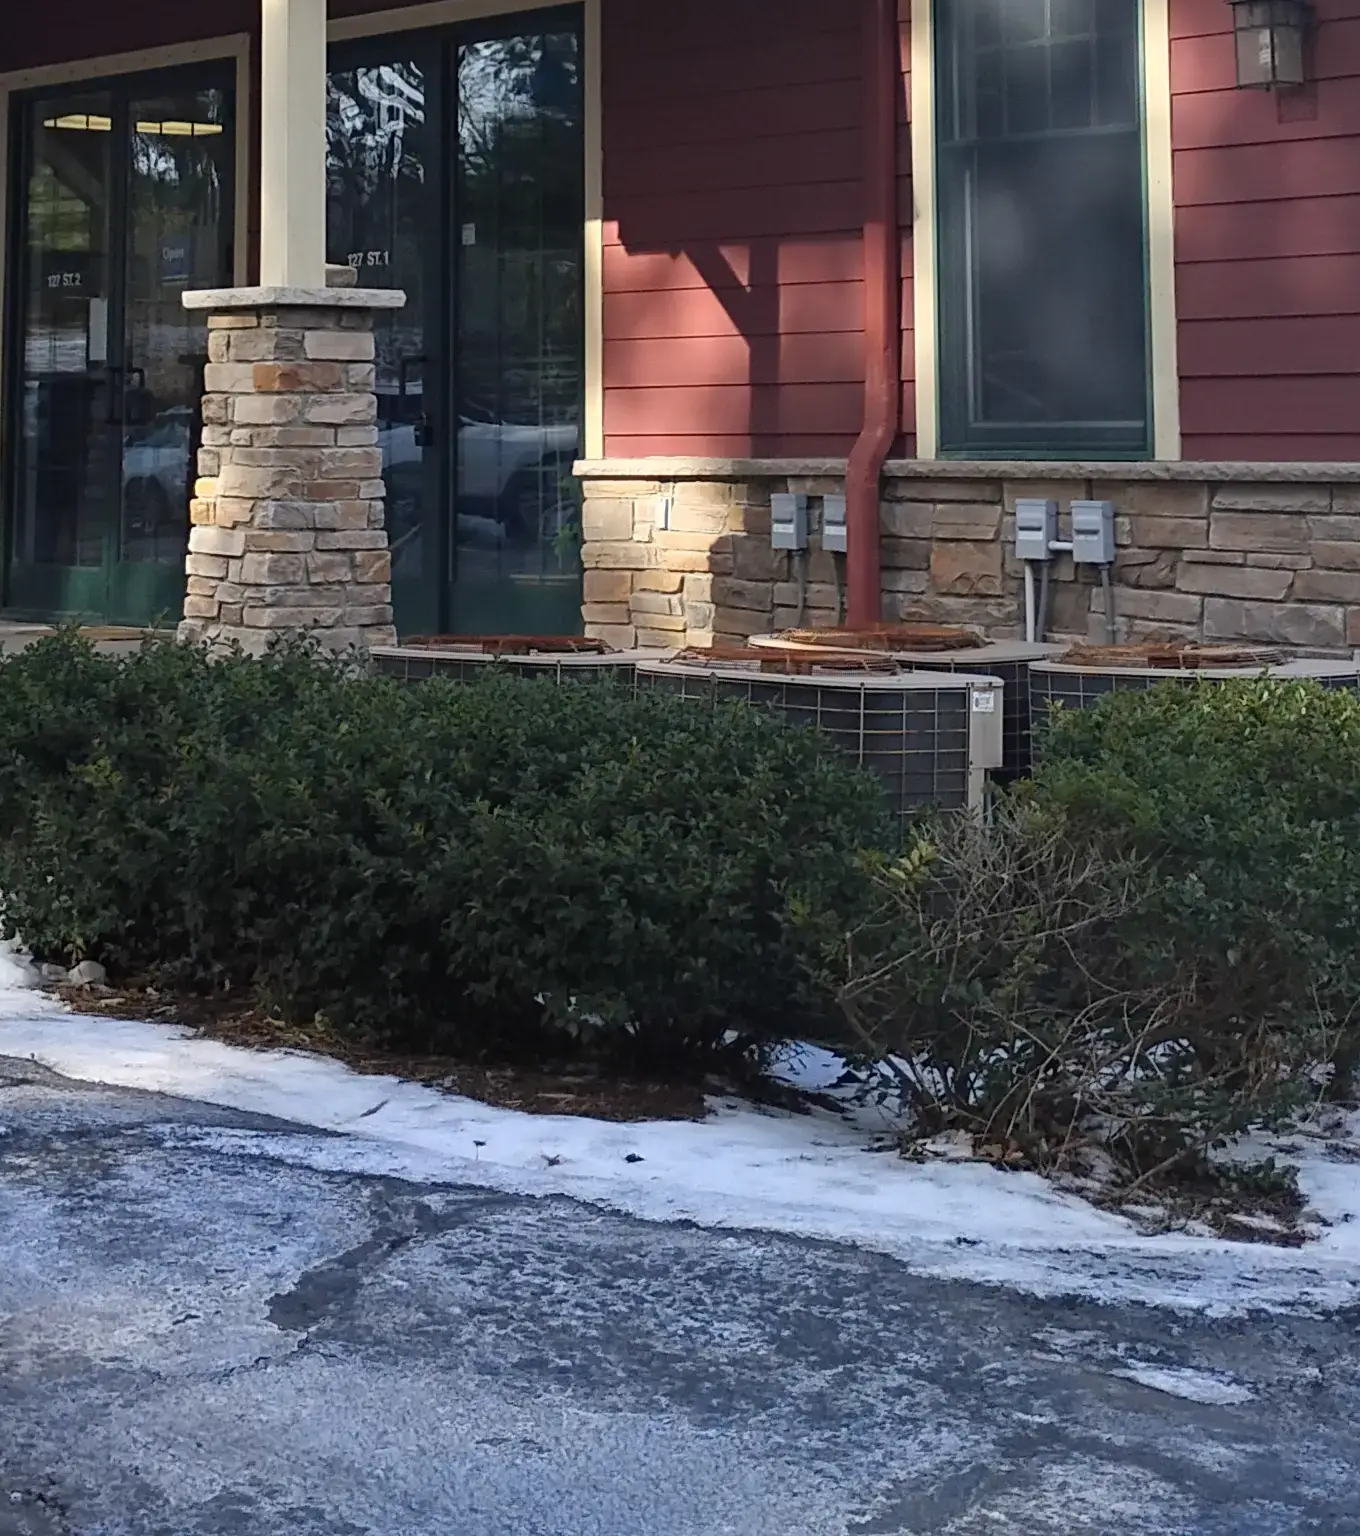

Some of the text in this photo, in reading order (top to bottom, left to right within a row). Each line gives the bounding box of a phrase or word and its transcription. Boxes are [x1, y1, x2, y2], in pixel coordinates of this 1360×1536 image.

[162, 247, 184, 262] Open
[347, 252, 364, 267] 127
[47, 274, 61, 288] 127
